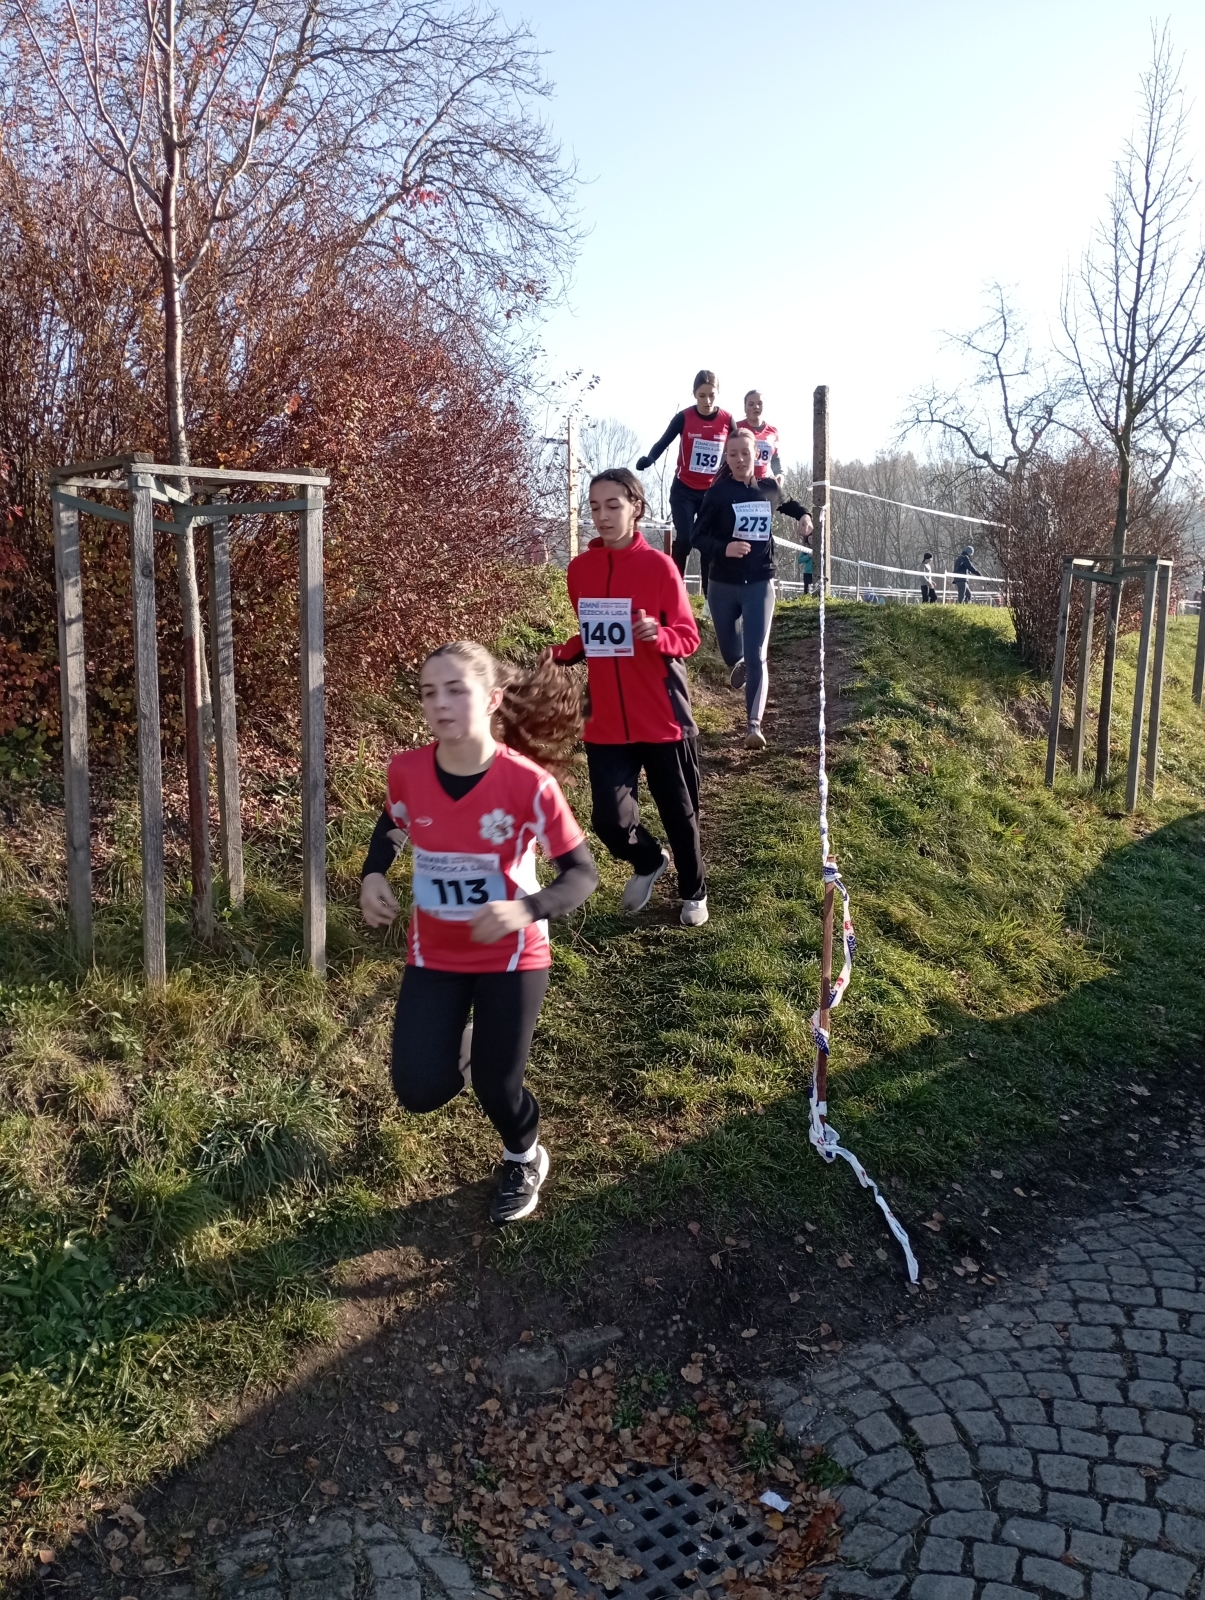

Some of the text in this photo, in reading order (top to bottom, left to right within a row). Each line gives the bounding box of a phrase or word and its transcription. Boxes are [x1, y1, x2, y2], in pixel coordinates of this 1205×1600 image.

[695, 453, 718, 468] 139
[738, 516, 768, 532] 273
[582, 622, 626, 645] 140
[431, 878, 489, 905] 113
